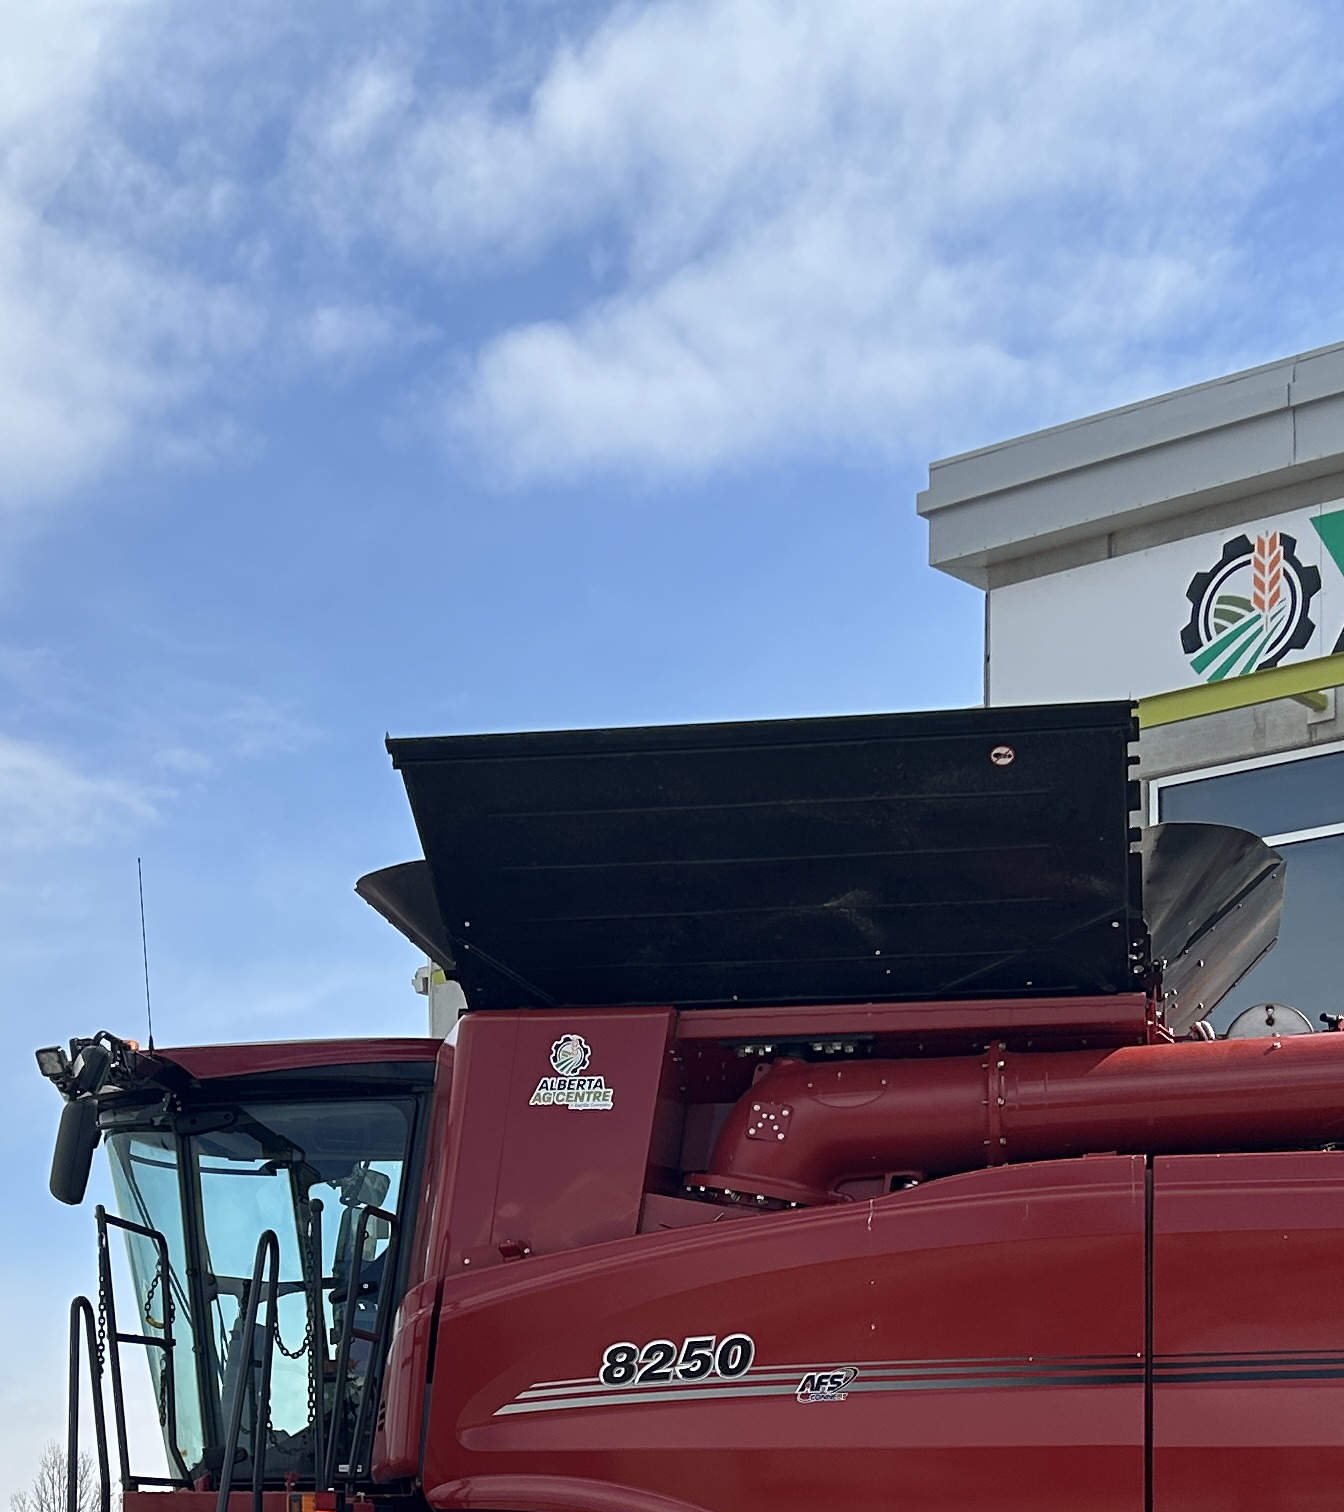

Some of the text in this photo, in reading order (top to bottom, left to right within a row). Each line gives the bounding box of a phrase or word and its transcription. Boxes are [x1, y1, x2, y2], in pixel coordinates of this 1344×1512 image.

[539, 1079, 603, 1090] ALBERTA
[532, 1091, 611, 1103] AG CENTRE
[599, 1333, 755, 1387] 8250
[796, 1371, 847, 1394] AFS
